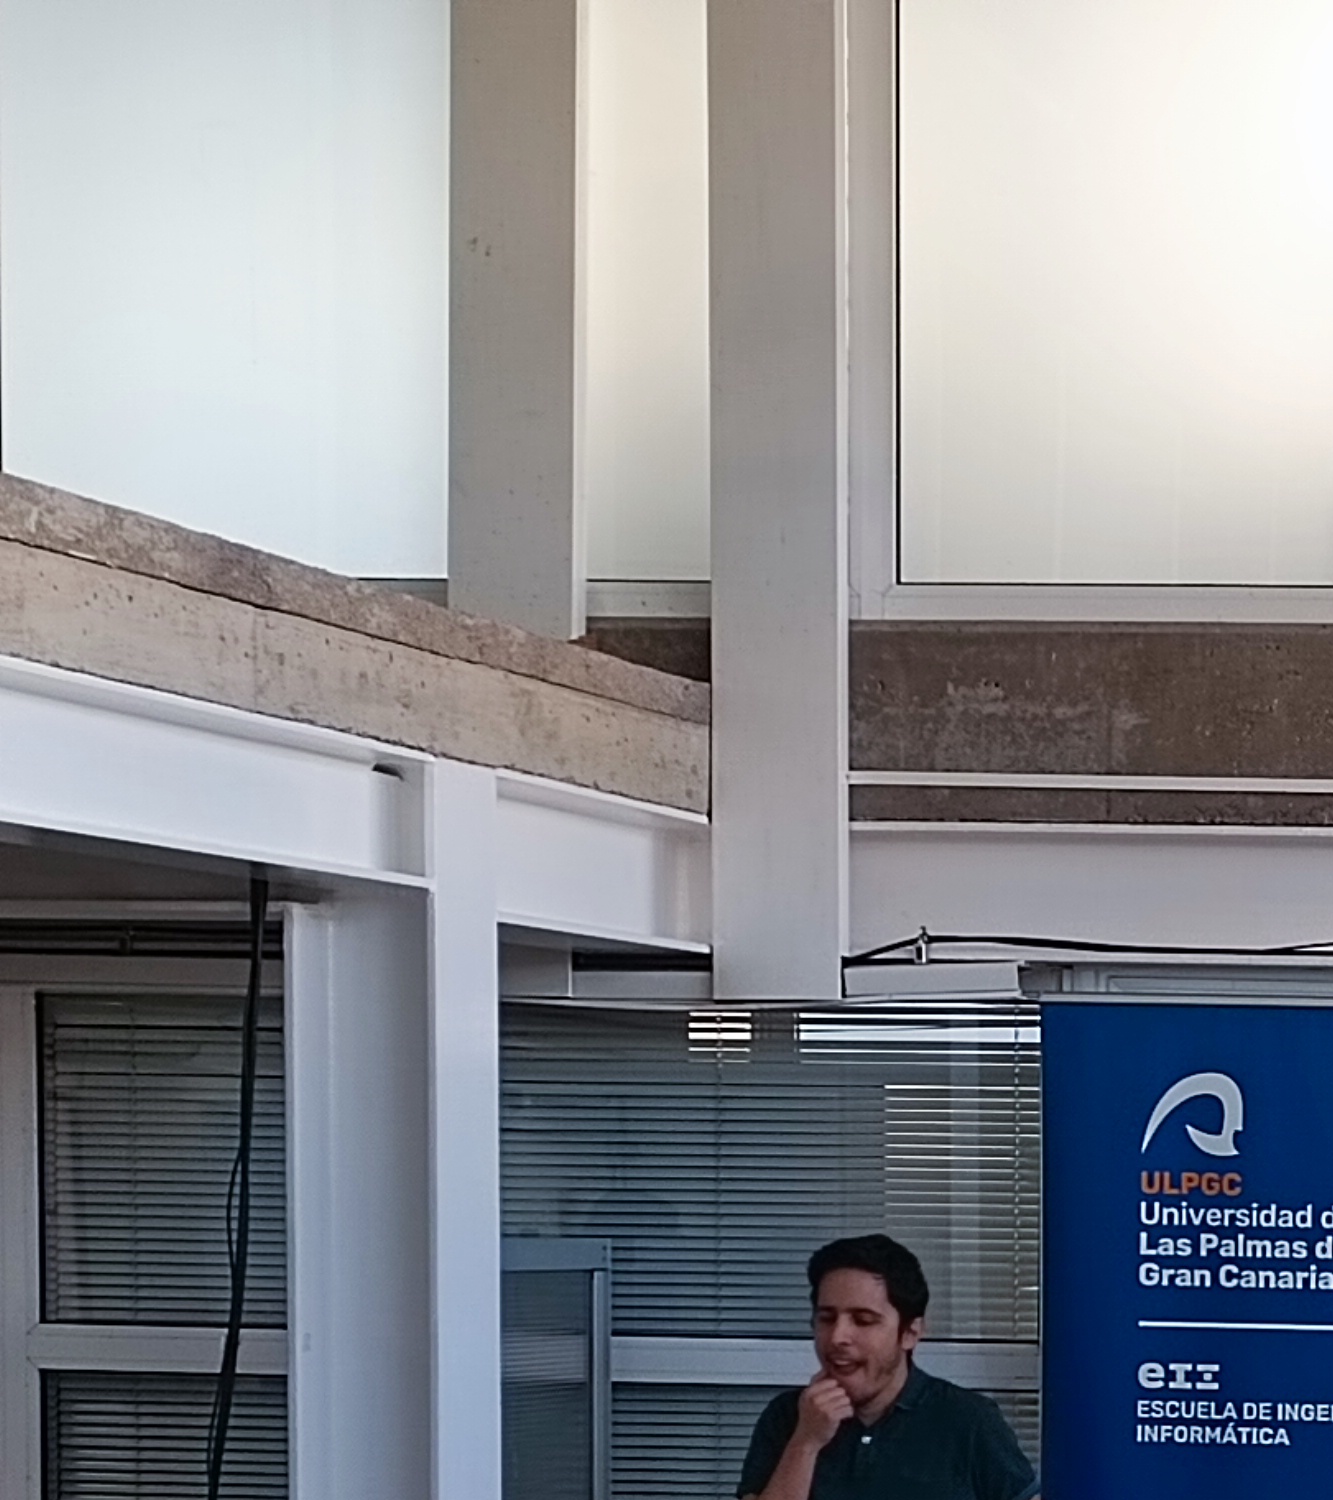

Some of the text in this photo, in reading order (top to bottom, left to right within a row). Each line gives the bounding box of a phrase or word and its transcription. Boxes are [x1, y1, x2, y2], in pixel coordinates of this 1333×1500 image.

[1140, 1170, 1242, 1197] ULPGC
[1139, 1200, 1313, 1229] Universidad
[1138, 1231, 1192, 1257] Las
[1199, 1232, 1308, 1259] Palmas
[1138, 1262, 1212, 1288] Gran
[1136, 1399, 1238, 1421] ESCUELA
[1242, 1402, 1273, 1421] DE
[1136, 1421, 1291, 1446] INFORMÁTICA
